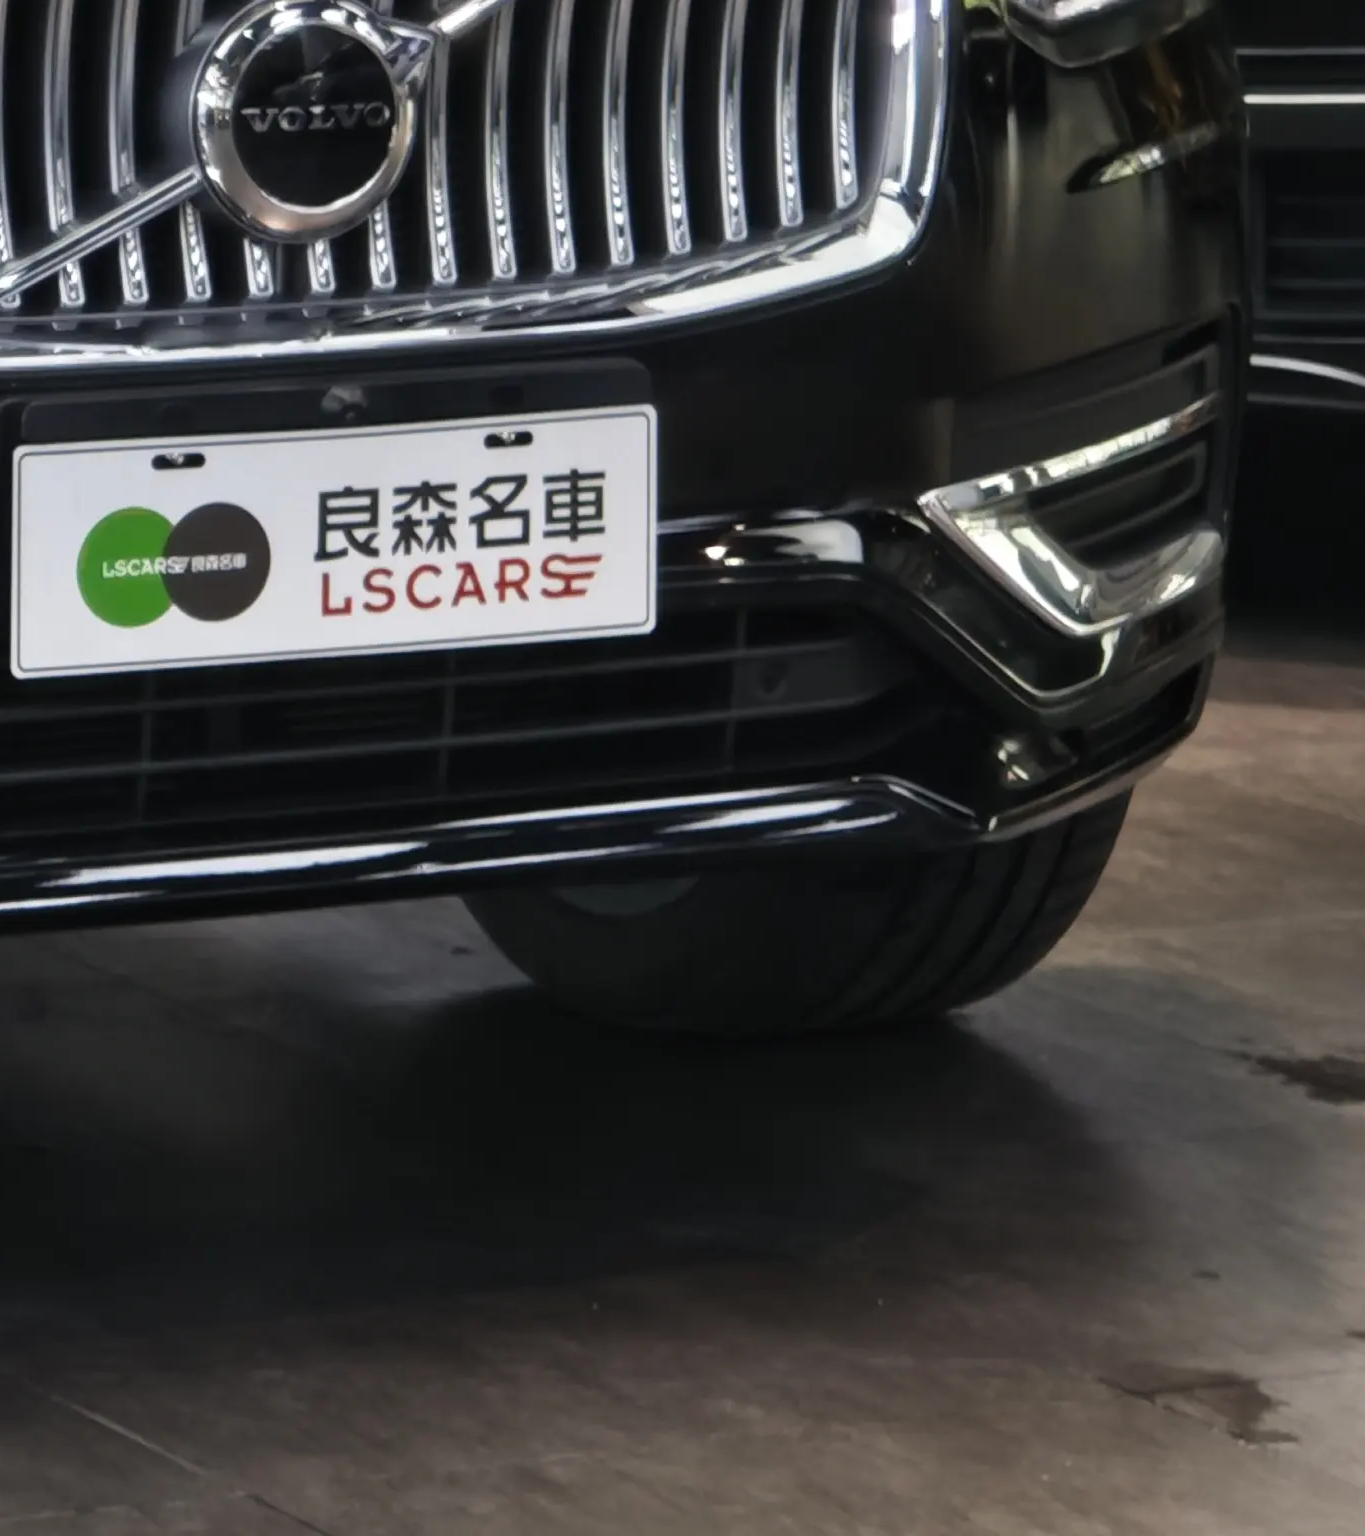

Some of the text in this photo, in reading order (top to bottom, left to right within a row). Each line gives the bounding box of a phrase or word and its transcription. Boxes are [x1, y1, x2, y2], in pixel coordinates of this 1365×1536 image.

[240, 101, 391, 133] VOLVO
[313, 468, 607, 562] 良森名車
